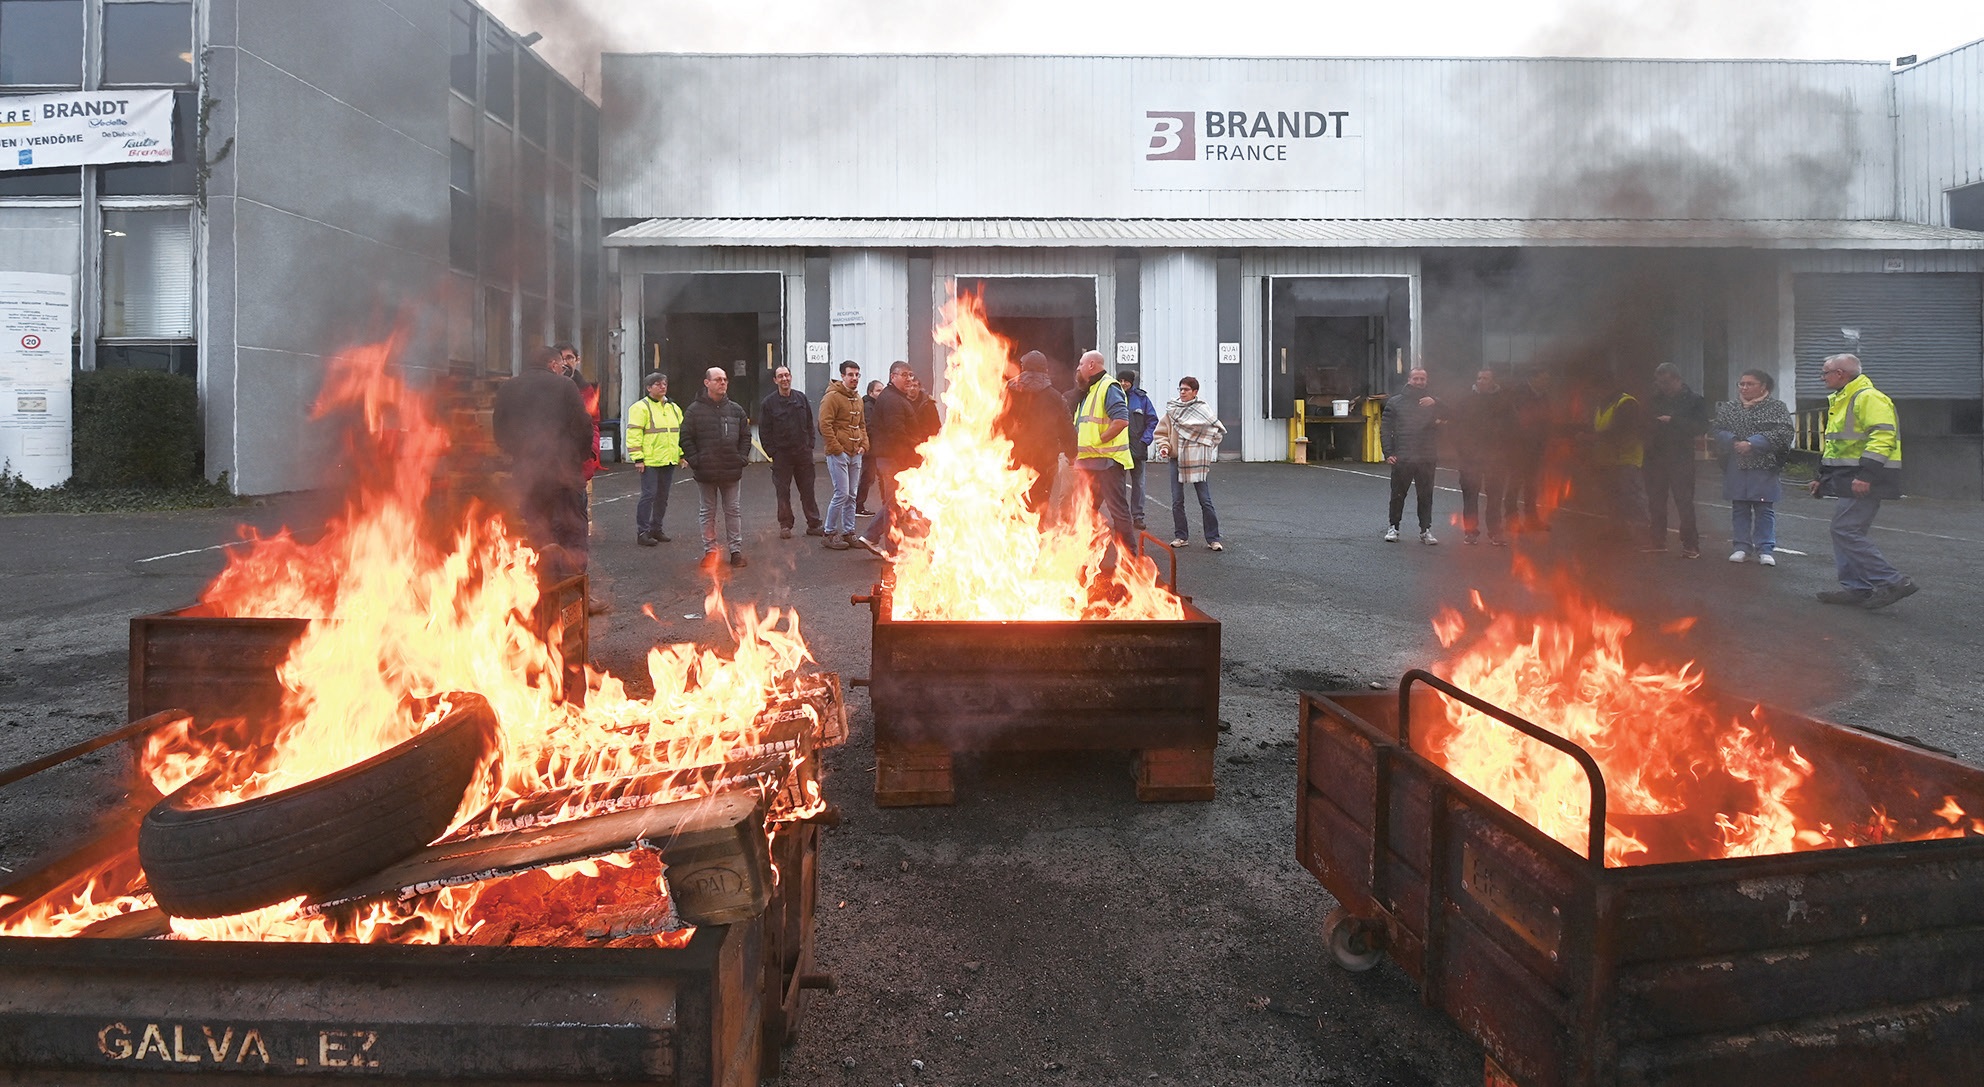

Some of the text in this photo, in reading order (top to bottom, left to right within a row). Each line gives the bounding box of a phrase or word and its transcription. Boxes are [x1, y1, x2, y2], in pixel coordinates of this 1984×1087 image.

[0, 101, 129, 123] RE BRANDT
[1205, 110, 1350, 139] BRANDT
[0, 139, 17, 148] EN
[26, 133, 84, 147] VENDÔME
[122, 137, 160, 149] Sauter
[1205, 144, 1288, 161] FRANCE
[25, 338, 37, 346] 20
[97, 1021, 271, 1065] GALVA
